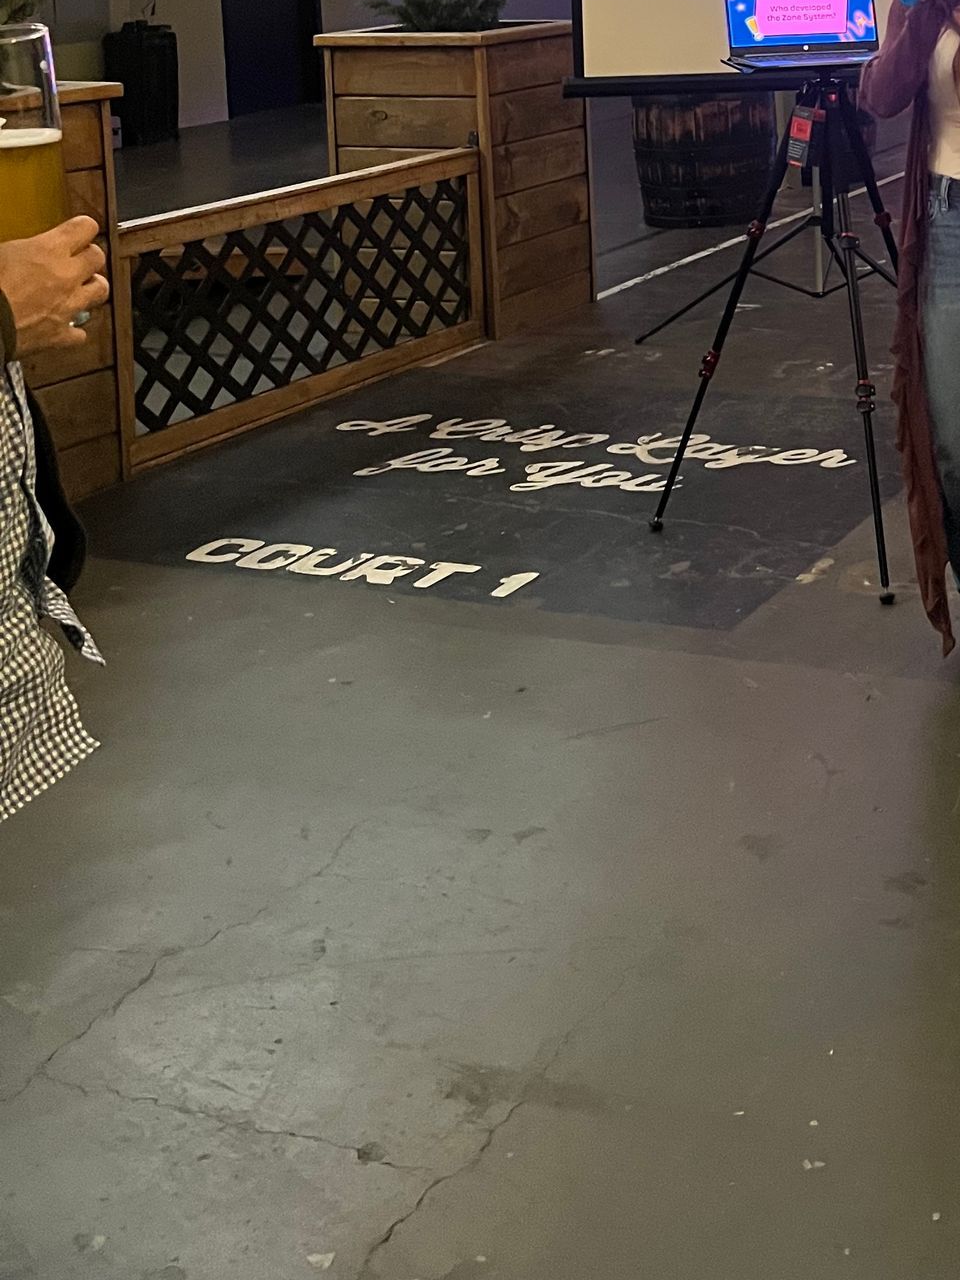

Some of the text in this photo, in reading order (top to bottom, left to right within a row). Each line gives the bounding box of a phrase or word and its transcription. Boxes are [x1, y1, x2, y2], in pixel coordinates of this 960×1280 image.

[767, 14, 781, 22] the
[790, 3, 832, 12] developed
[429, 417, 610, 452] Crisp
[606, 431, 857, 470] Lager
[353, 448, 683, 493] for You
[185, 538, 540, 598] COURT 1
